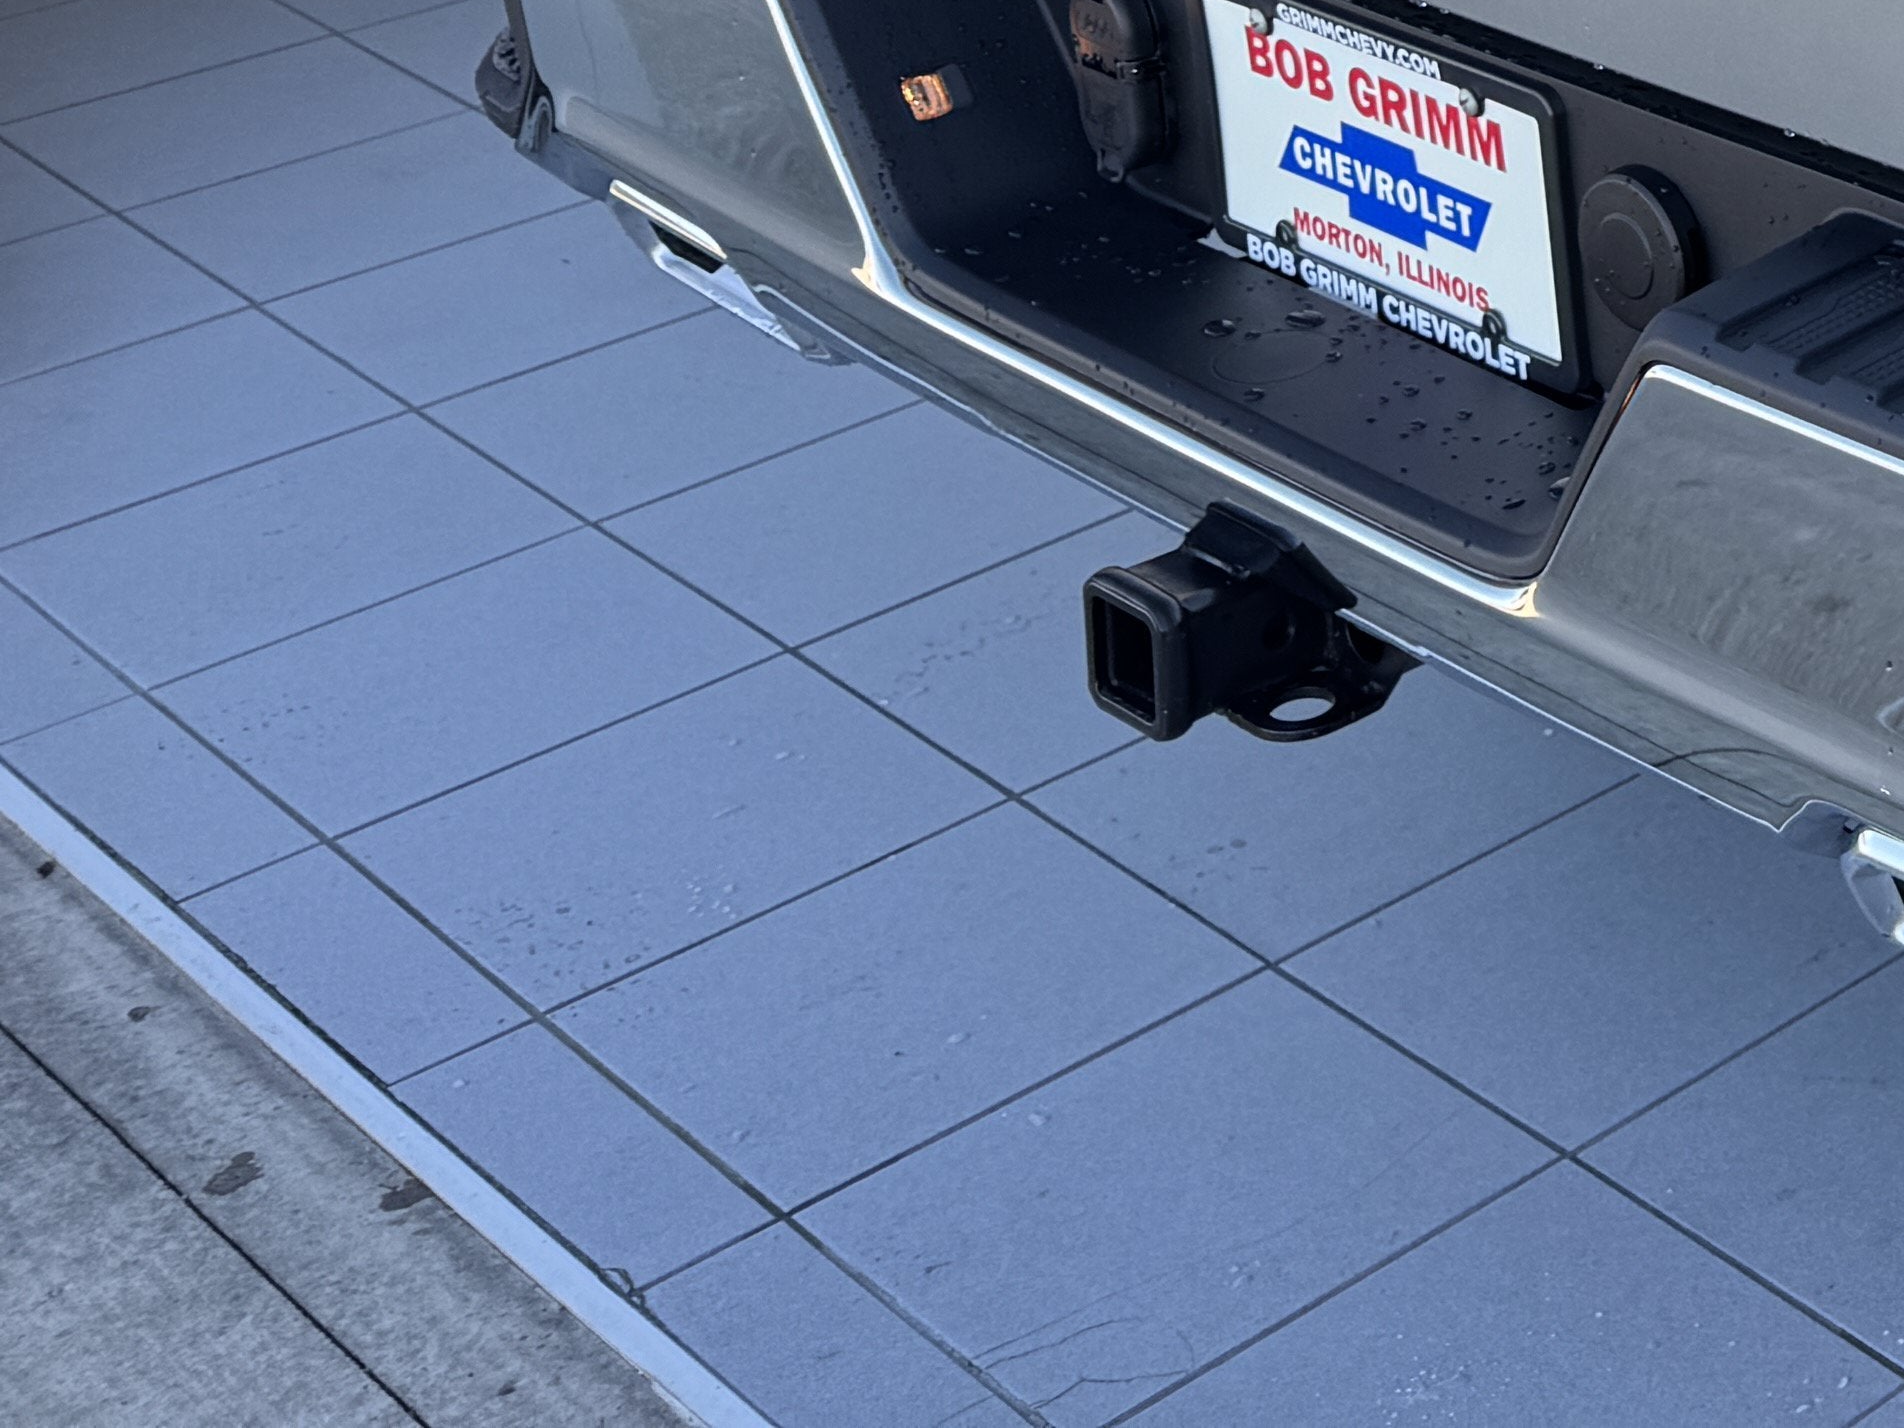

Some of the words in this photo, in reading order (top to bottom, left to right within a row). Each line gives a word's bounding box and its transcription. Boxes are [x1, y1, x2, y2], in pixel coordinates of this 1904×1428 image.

[1276, 2, 1442, 81] GRIMMCHEVY.COM
[1244, 24, 1335, 102] BOB
[1348, 66, 1508, 174] GRIMM
[1292, 135, 1473, 238] CHEVROLET
[1246, 233, 1297, 277] BOB
[1300, 257, 1378, 315] GRIMM
[1382, 295, 1532, 381] CHEVROLET
[1293, 206, 1391, 276] MORTON,
[1397, 251, 1490, 312] ILLINOIS
